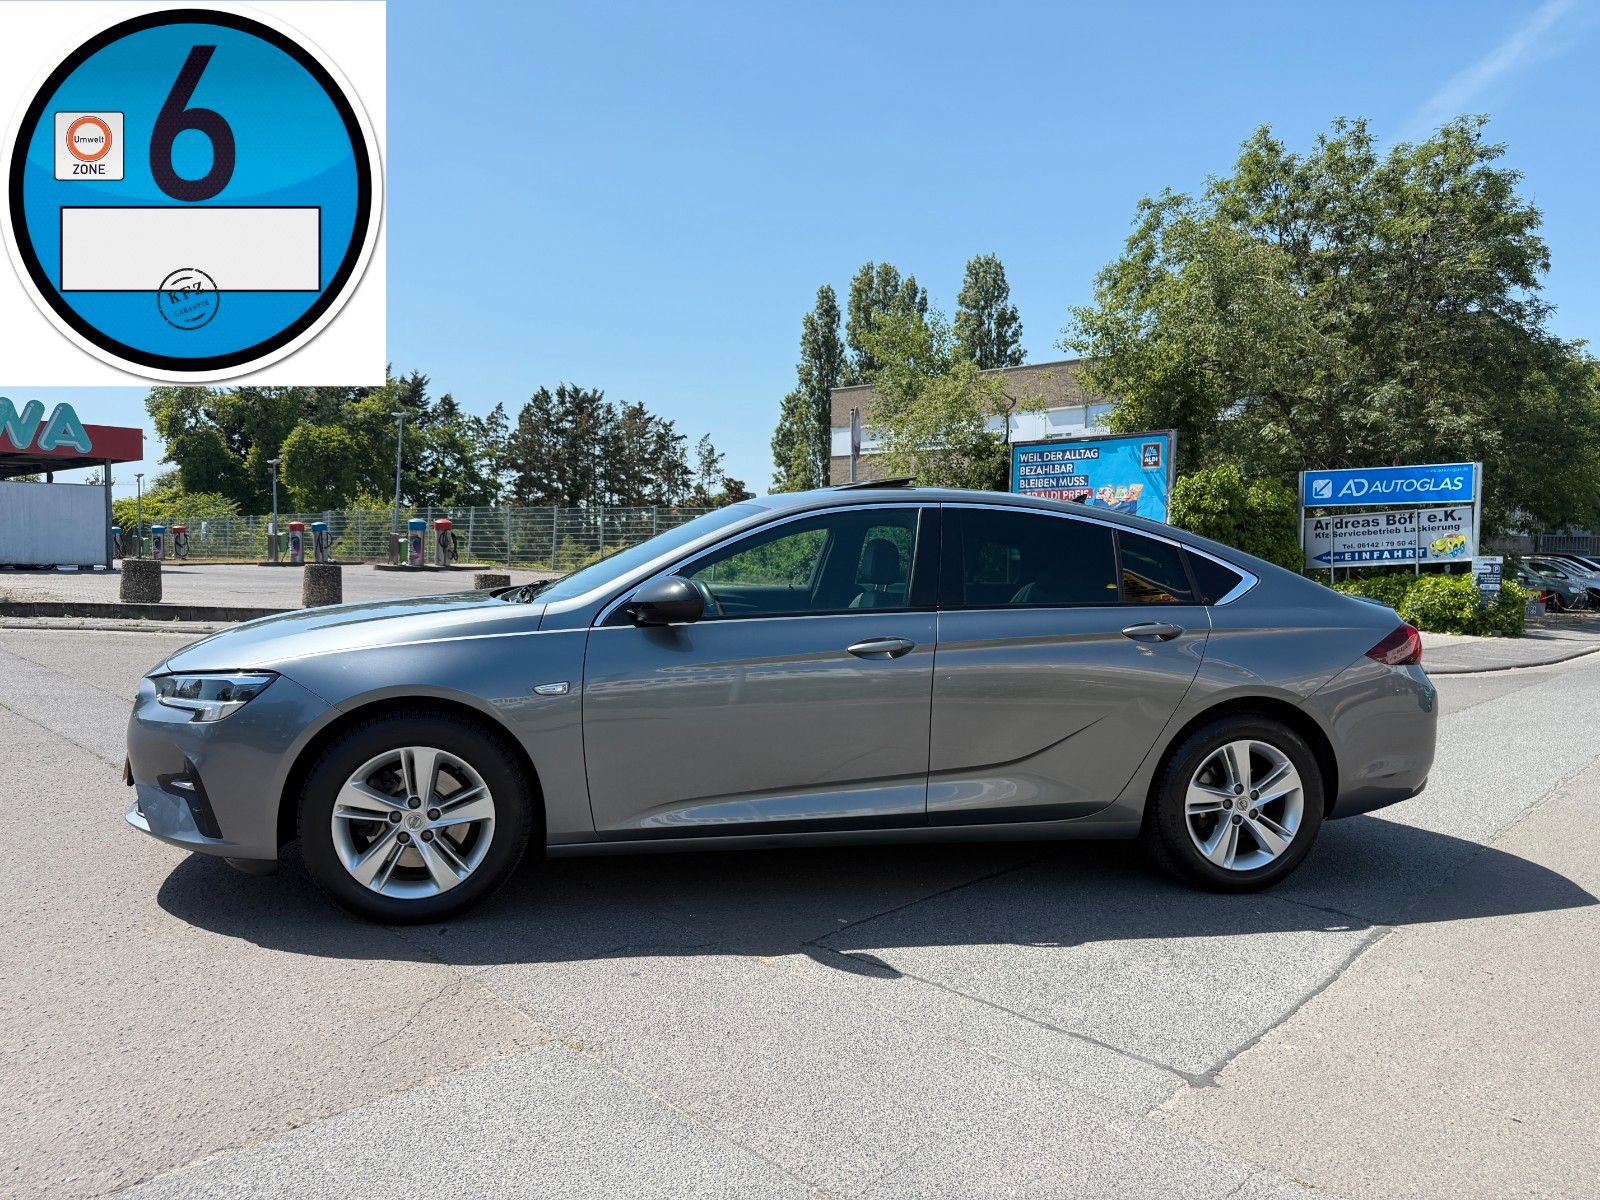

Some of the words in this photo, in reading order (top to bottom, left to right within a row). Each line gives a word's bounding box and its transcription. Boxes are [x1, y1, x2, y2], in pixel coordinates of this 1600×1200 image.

[1019, 452, 1042, 463] WEIL
[1044, 450, 1063, 462] DER
[1065, 449, 1099, 461] ALLTAG
[1019, 465, 1073, 476] BEZAHLBAR
[1019, 477, 1057, 488] BLEIBEN
[1059, 475, 1088, 487] MUSS.
[1369, 476, 1464, 494] AUTOGLAS
[1427, 509, 1462, 523] e.K.
[1344, 549, 1425, 560] EINFAHRT
